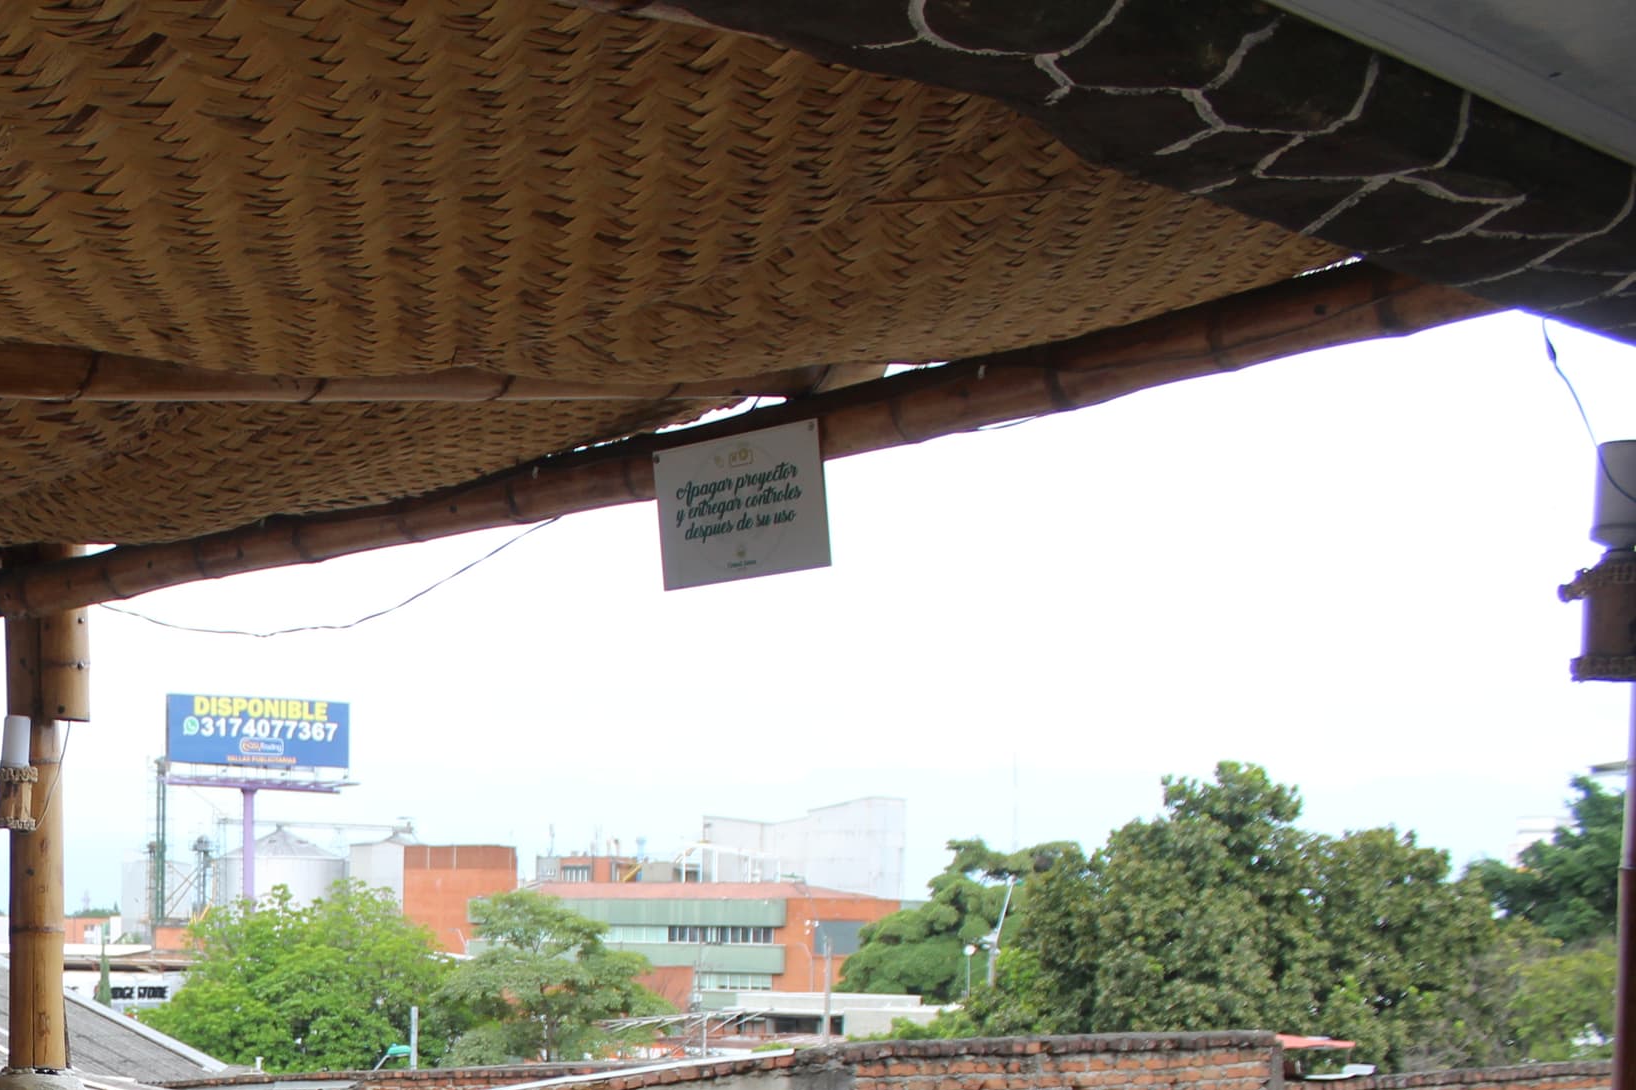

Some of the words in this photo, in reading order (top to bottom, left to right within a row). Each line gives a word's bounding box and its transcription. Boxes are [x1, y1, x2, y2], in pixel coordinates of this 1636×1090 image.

[676, 478, 732, 506] Apagar
[735, 461, 798, 495] proyector
[676, 508, 685, 528] y
[688, 496, 741, 520] entregar
[746, 483, 802, 508] controles
[685, 520, 733, 543] despues
[737, 512, 753, 530] de
[756, 513, 771, 527] su
[774, 510, 796, 524] uso
[193, 695, 328, 721] DISPONIBLE
[200, 717, 338, 742] 3174077367
